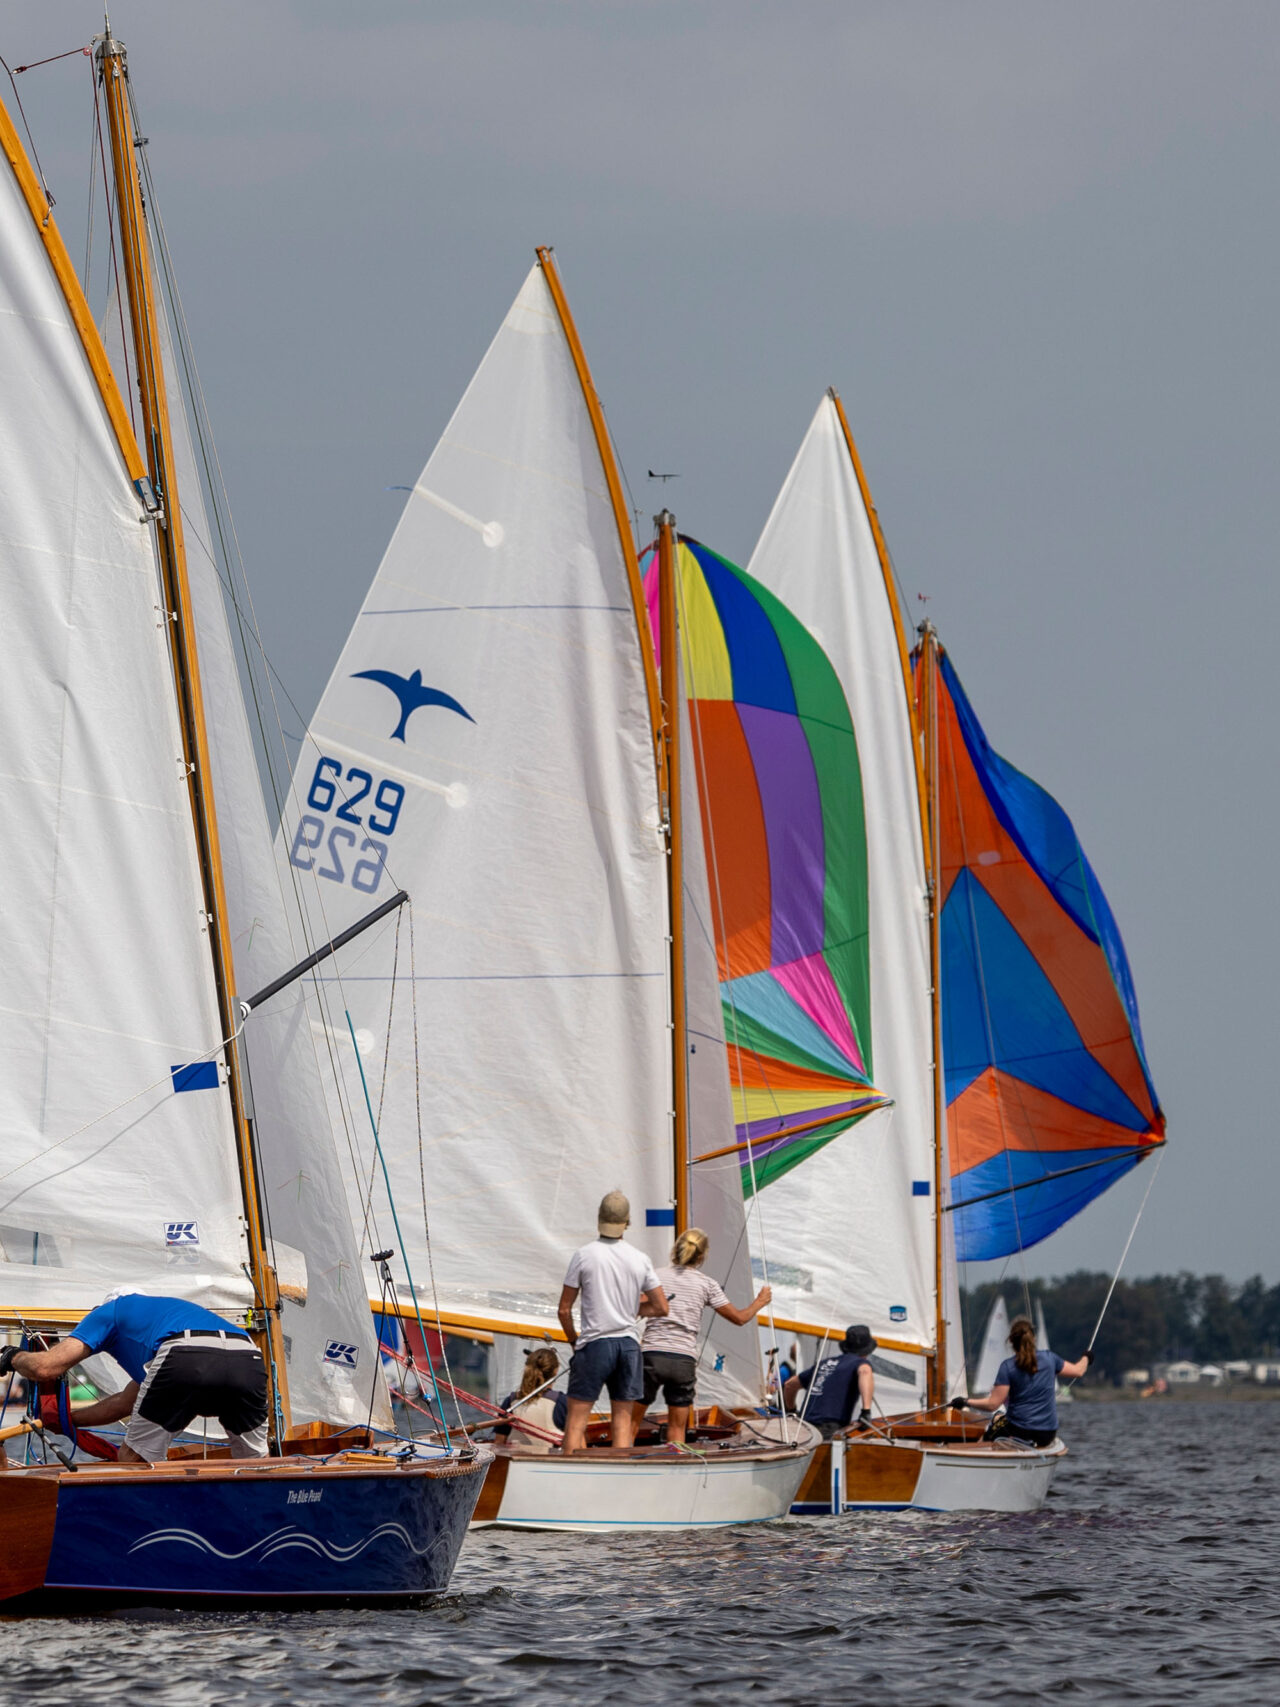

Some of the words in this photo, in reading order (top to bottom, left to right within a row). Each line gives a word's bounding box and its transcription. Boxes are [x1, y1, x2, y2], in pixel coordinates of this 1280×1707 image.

[307, 756, 406, 836] 629
[166, 1223, 197, 1241] UK
[325, 1342, 357, 1364] UK
[286, 1490, 298, 1504] The
